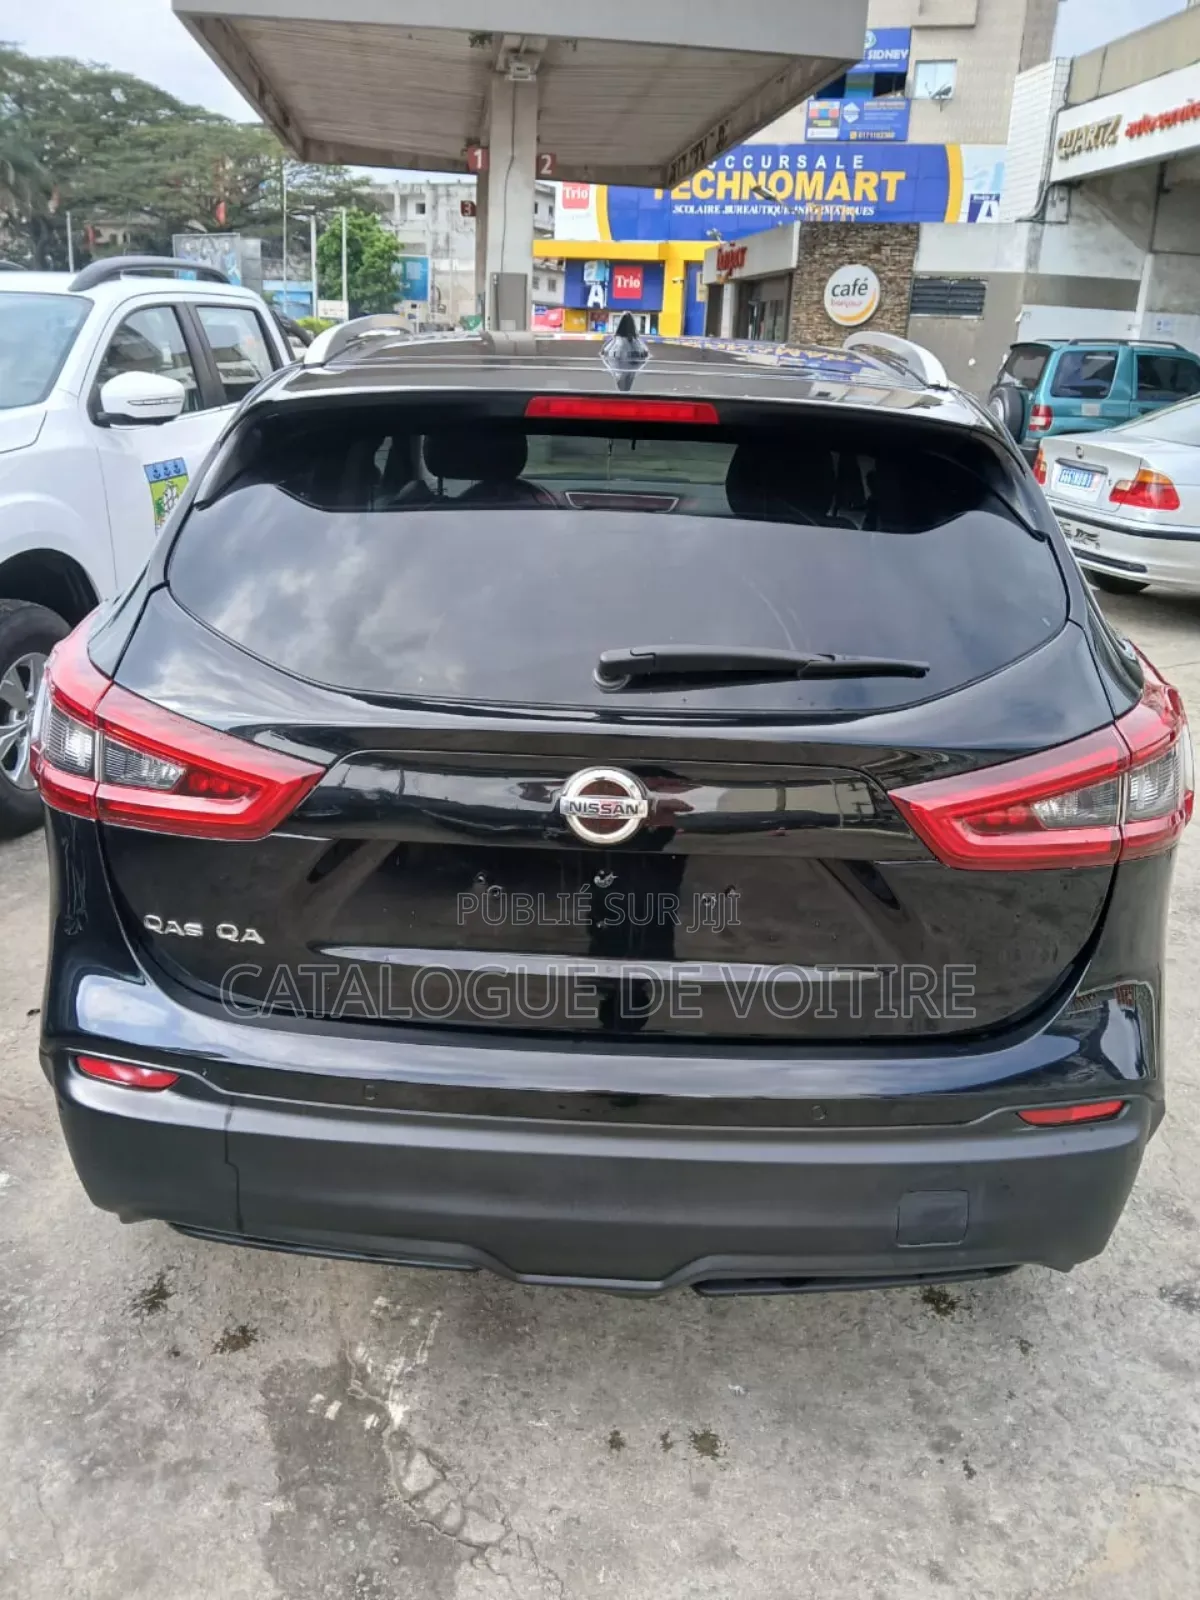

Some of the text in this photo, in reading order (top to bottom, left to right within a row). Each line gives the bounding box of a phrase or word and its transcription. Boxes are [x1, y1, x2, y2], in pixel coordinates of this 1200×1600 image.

[867, 49, 909, 61] SIDNEY
[1056, 114, 1123, 160] QUARTZ
[473, 148, 483, 169] 1
[540, 154, 553, 175] 2
[564, 186, 589, 200] Trio
[615, 274, 641, 288] Trio
[831, 277, 868, 297] café
[569, 800, 639, 815] NISSAN
[143, 914, 265, 945] QAS QA
